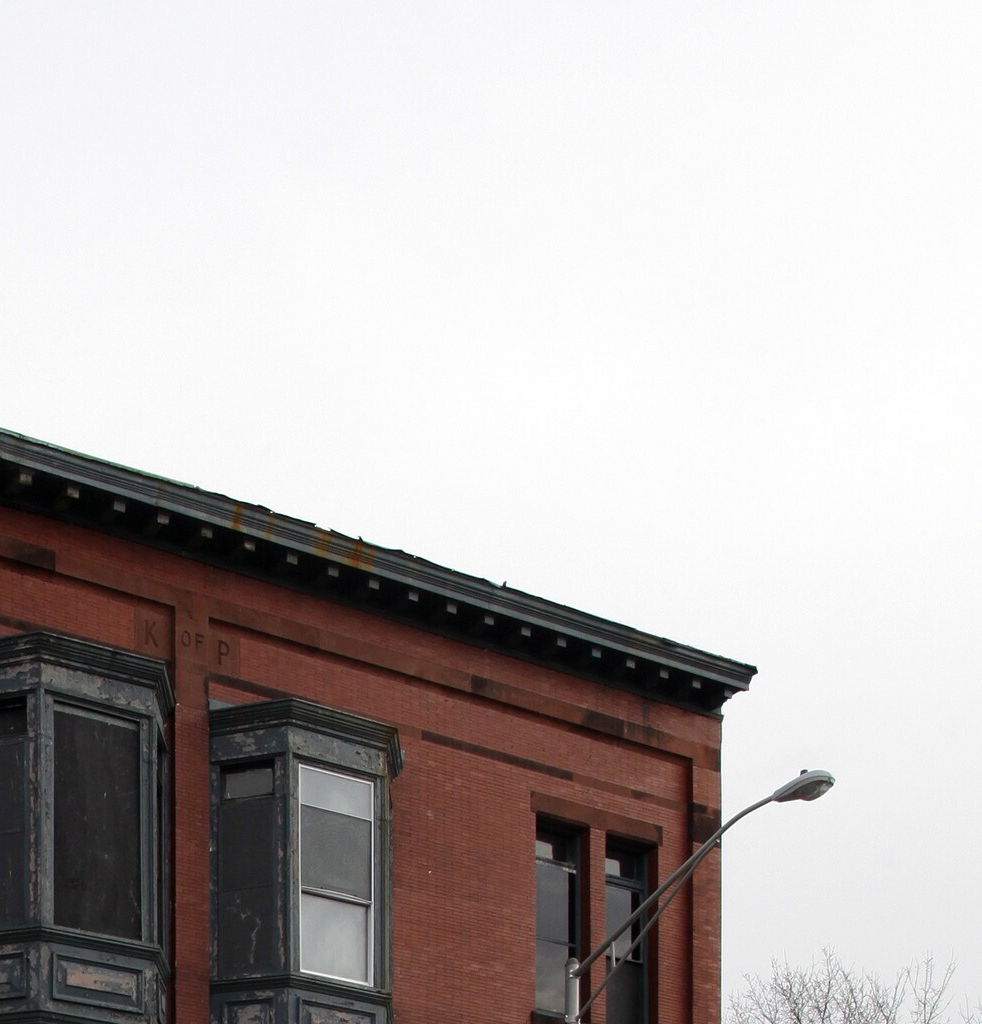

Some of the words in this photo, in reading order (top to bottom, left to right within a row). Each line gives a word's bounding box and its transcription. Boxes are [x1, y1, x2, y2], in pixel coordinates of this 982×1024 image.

[144, 619, 159, 649] K
[181, 630, 205, 650] OF
[218, 639, 230, 666] P
